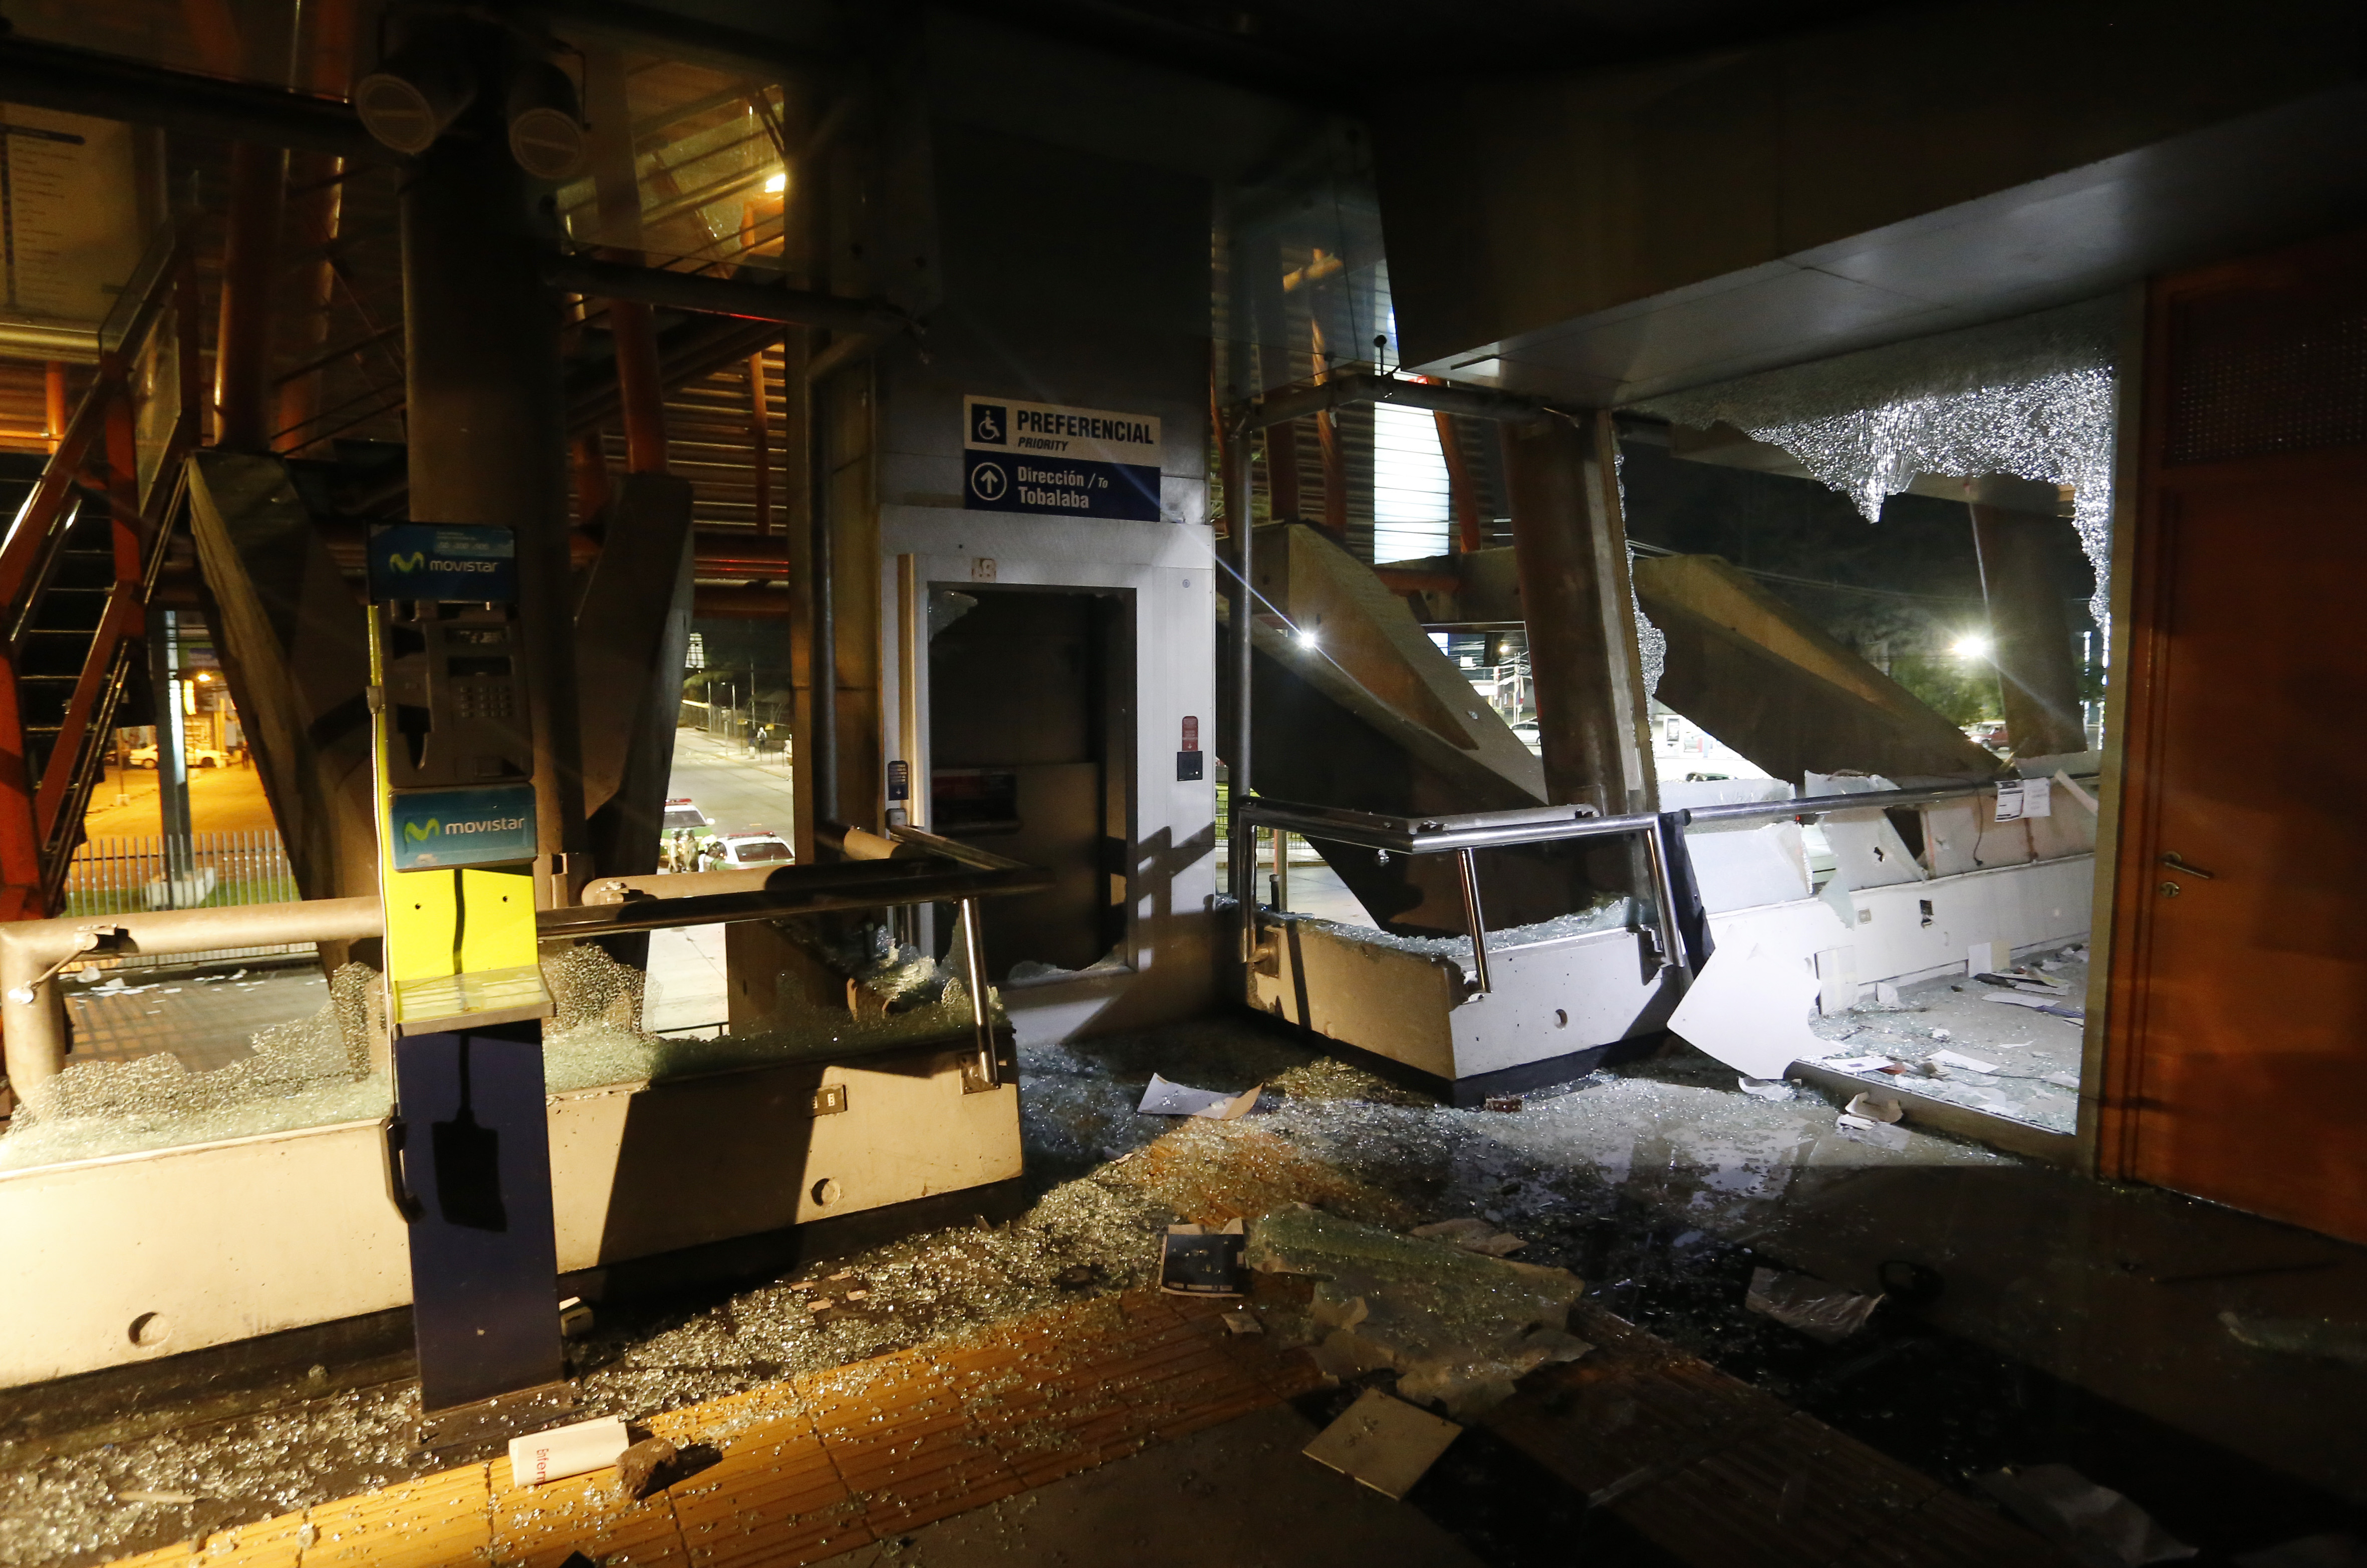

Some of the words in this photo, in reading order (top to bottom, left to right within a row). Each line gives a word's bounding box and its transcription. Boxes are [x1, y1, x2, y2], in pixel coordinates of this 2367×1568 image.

[1017, 410, 1154, 445] PREFERENCIAL
[1017, 436, 1069, 451] PRIORITY
[1018, 466, 1084, 487] Dirección
[1018, 486, 1089, 508] Tobalaba
[429, 560, 499, 572] movistar
[445, 817, 523, 835] movistar
